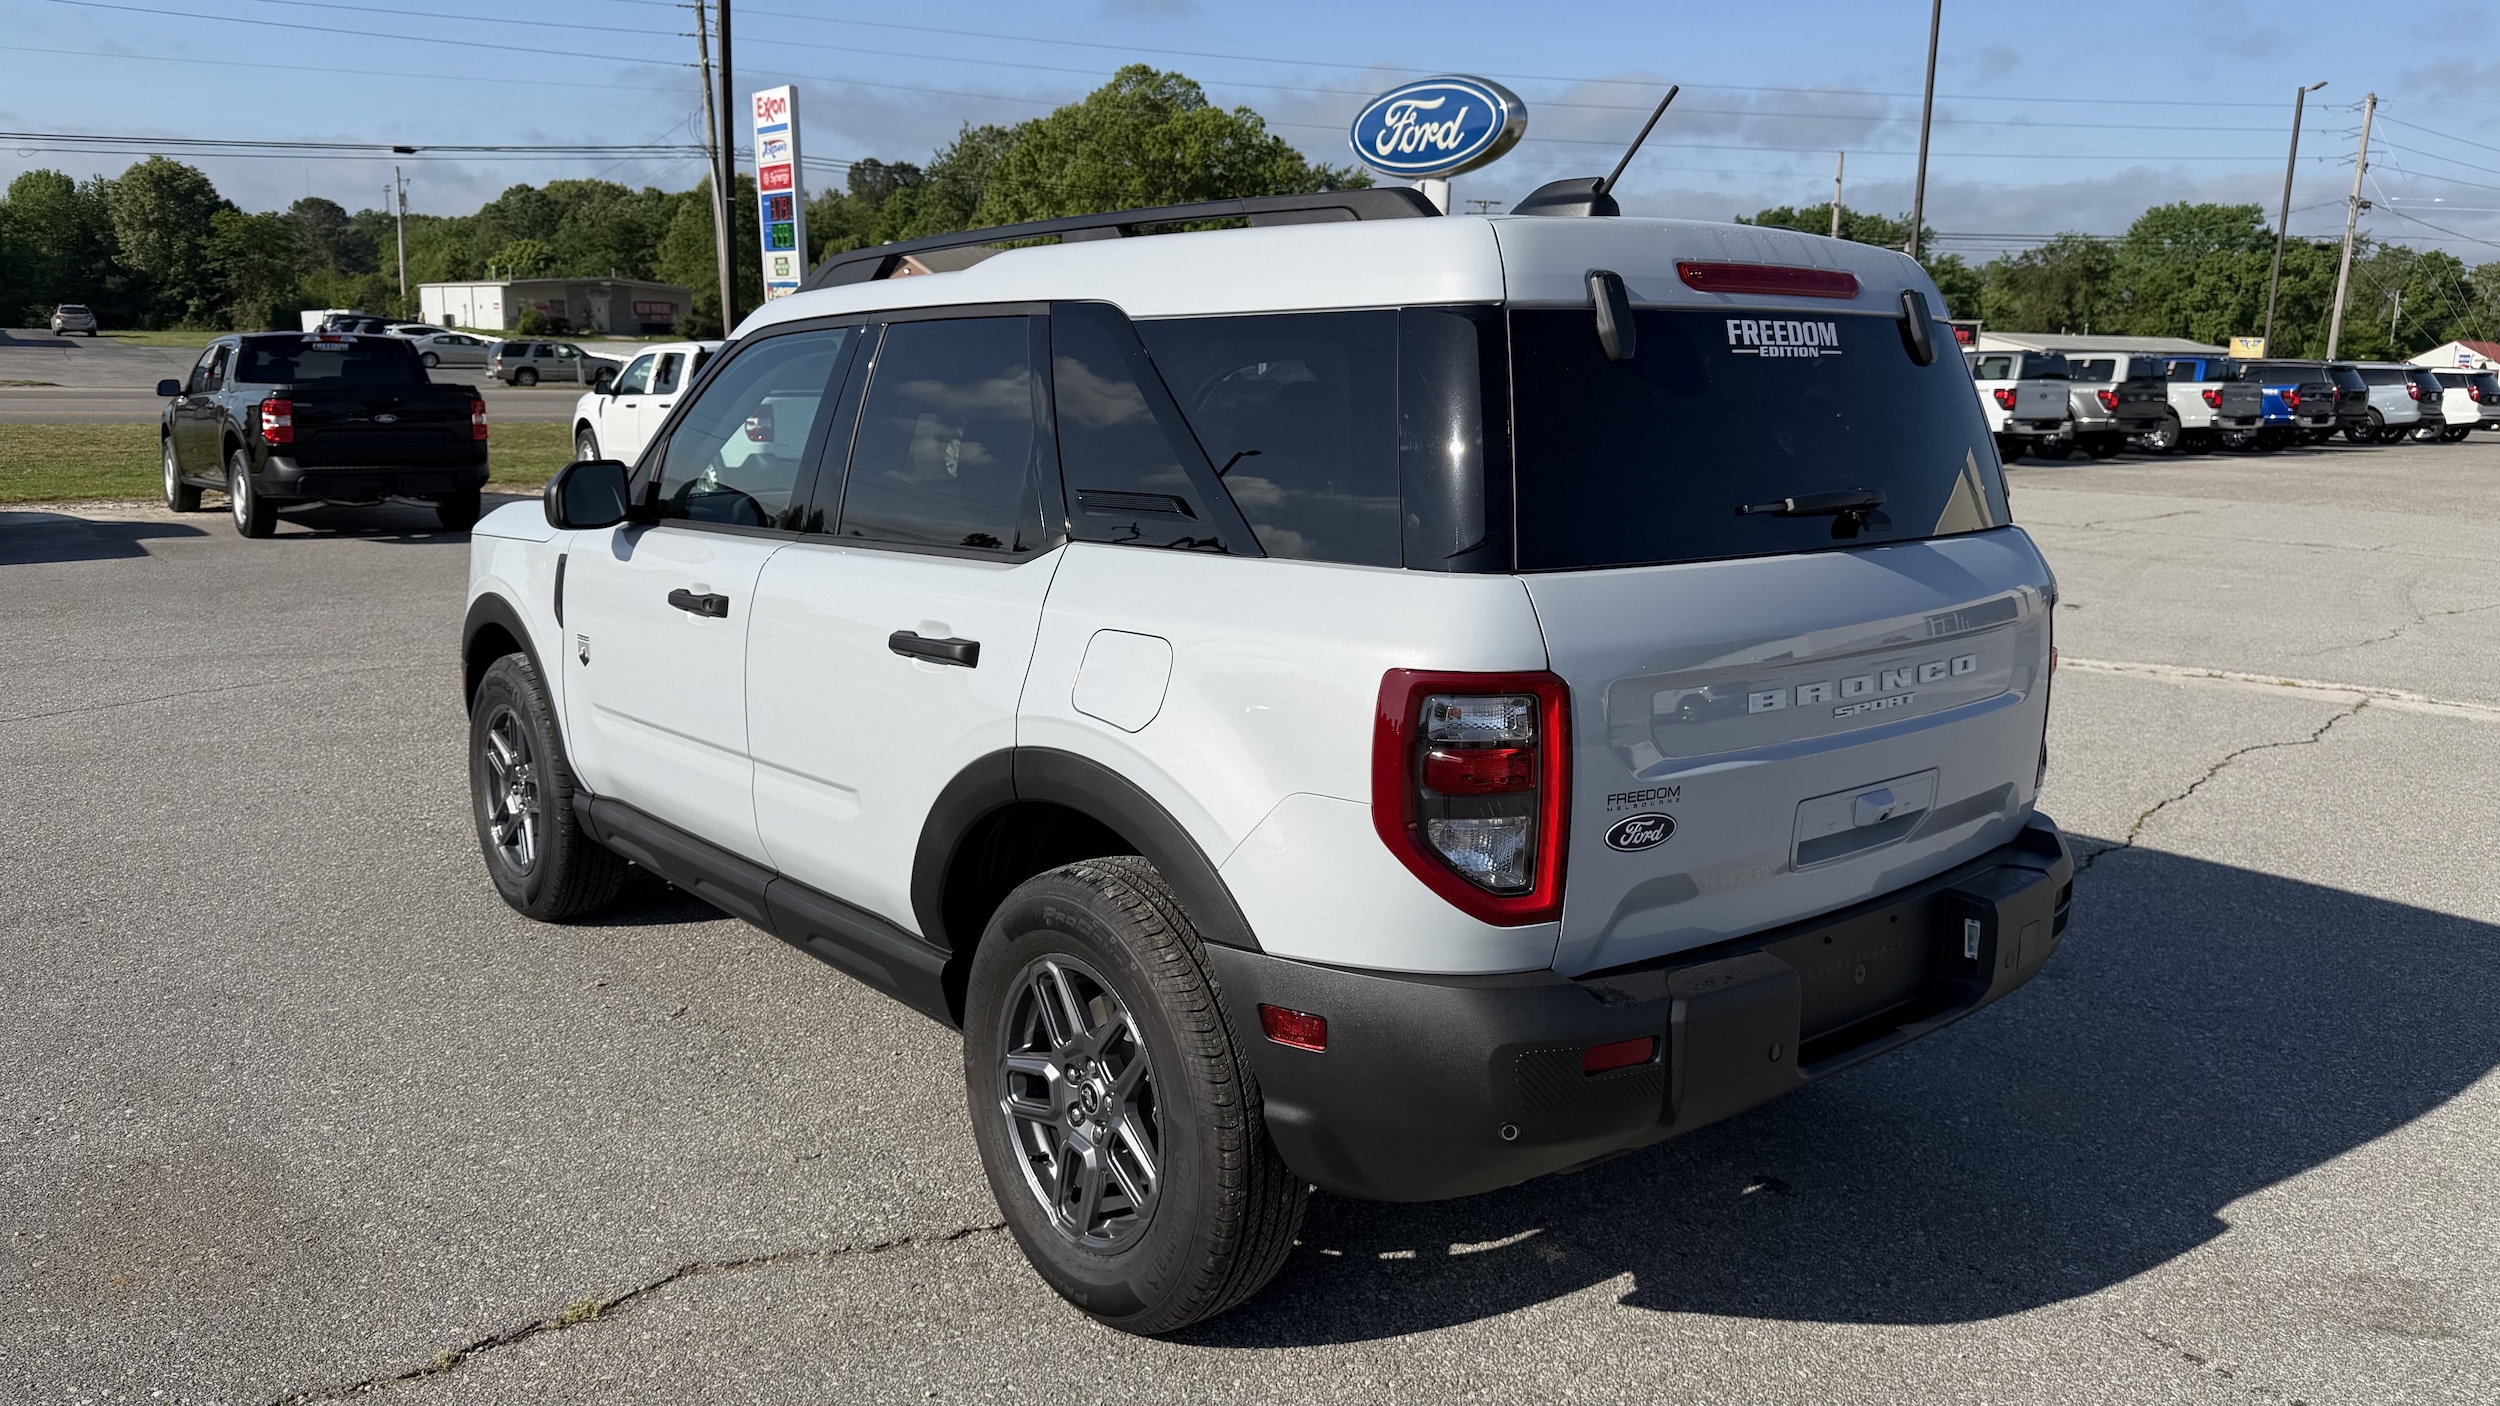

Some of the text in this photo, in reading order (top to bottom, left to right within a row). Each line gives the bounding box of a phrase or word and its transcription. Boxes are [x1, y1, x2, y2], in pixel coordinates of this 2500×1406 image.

[756, 97, 786, 122] Exxon
[1376, 96, 1469, 156] Ford
[1726, 319, 1839, 346] FREEDOM
[1759, 346, 1819, 357] EDITION
[1747, 653, 1976, 714] BRONCO
[1832, 692, 1917, 719] SPORT
[1606, 798, 1681, 812] MELBOURNE
[1607, 785, 1680, 806] FREEDOM
[1620, 820, 1665, 846] Ford
